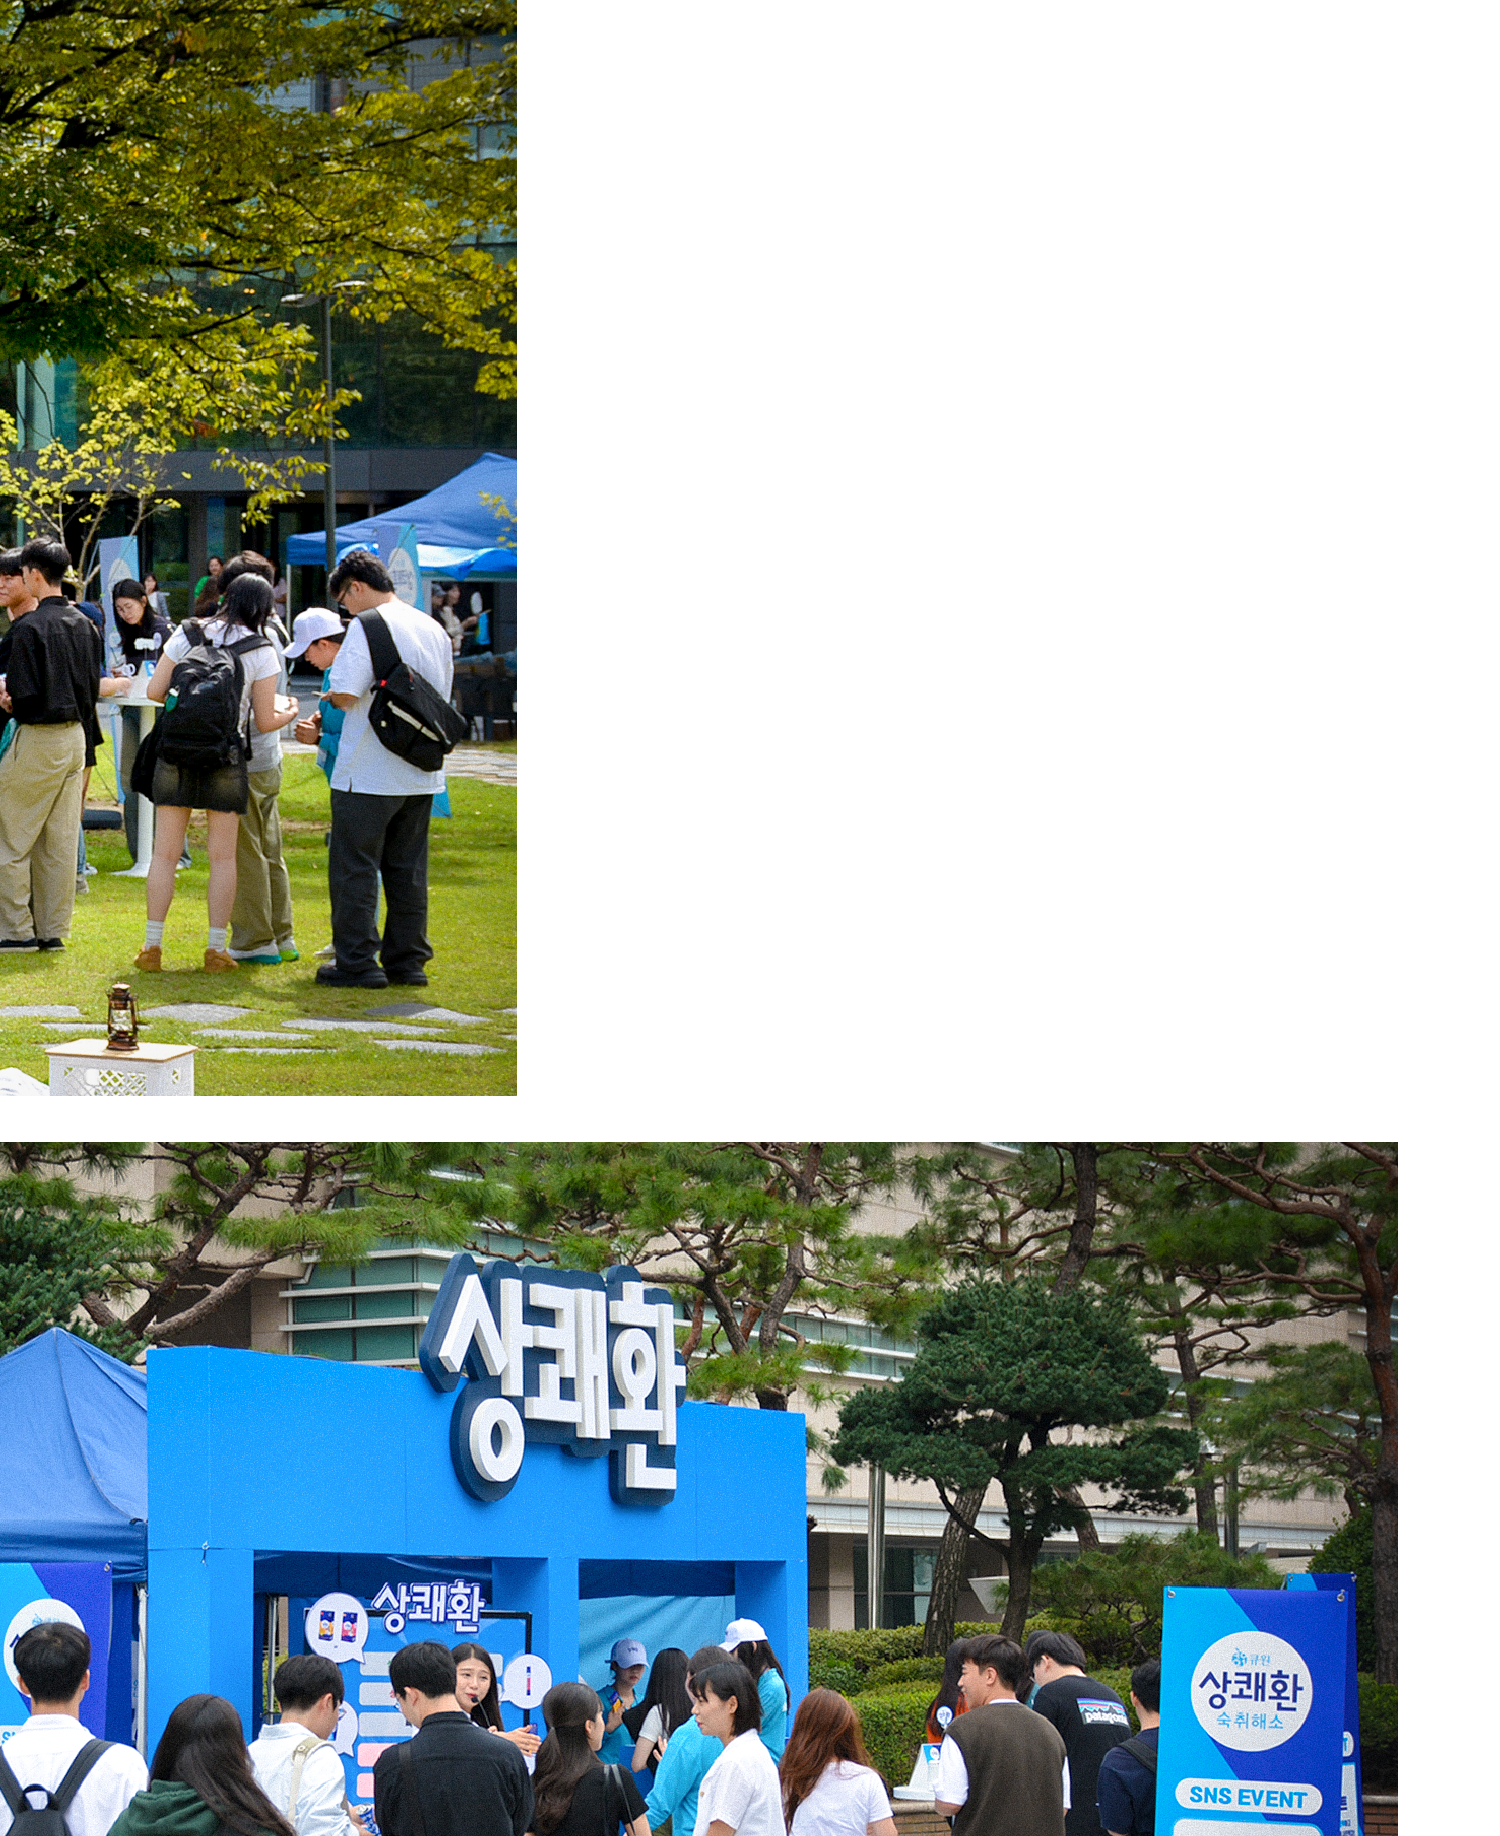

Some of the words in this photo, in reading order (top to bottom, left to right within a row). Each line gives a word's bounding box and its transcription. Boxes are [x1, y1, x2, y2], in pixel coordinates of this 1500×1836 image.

[438, 1278, 687, 1490] 상쾌환
[371, 1578, 486, 1635] 상쾌환
[1251, 1654, 1271, 1667] 큐원
[1198, 1669, 1305, 1712] 상쾌환
[1216, 1711, 1284, 1730] 숙취해소
[1189, 1786, 1232, 1804] SNS
[1238, 1788, 1309, 1809] EVENT
